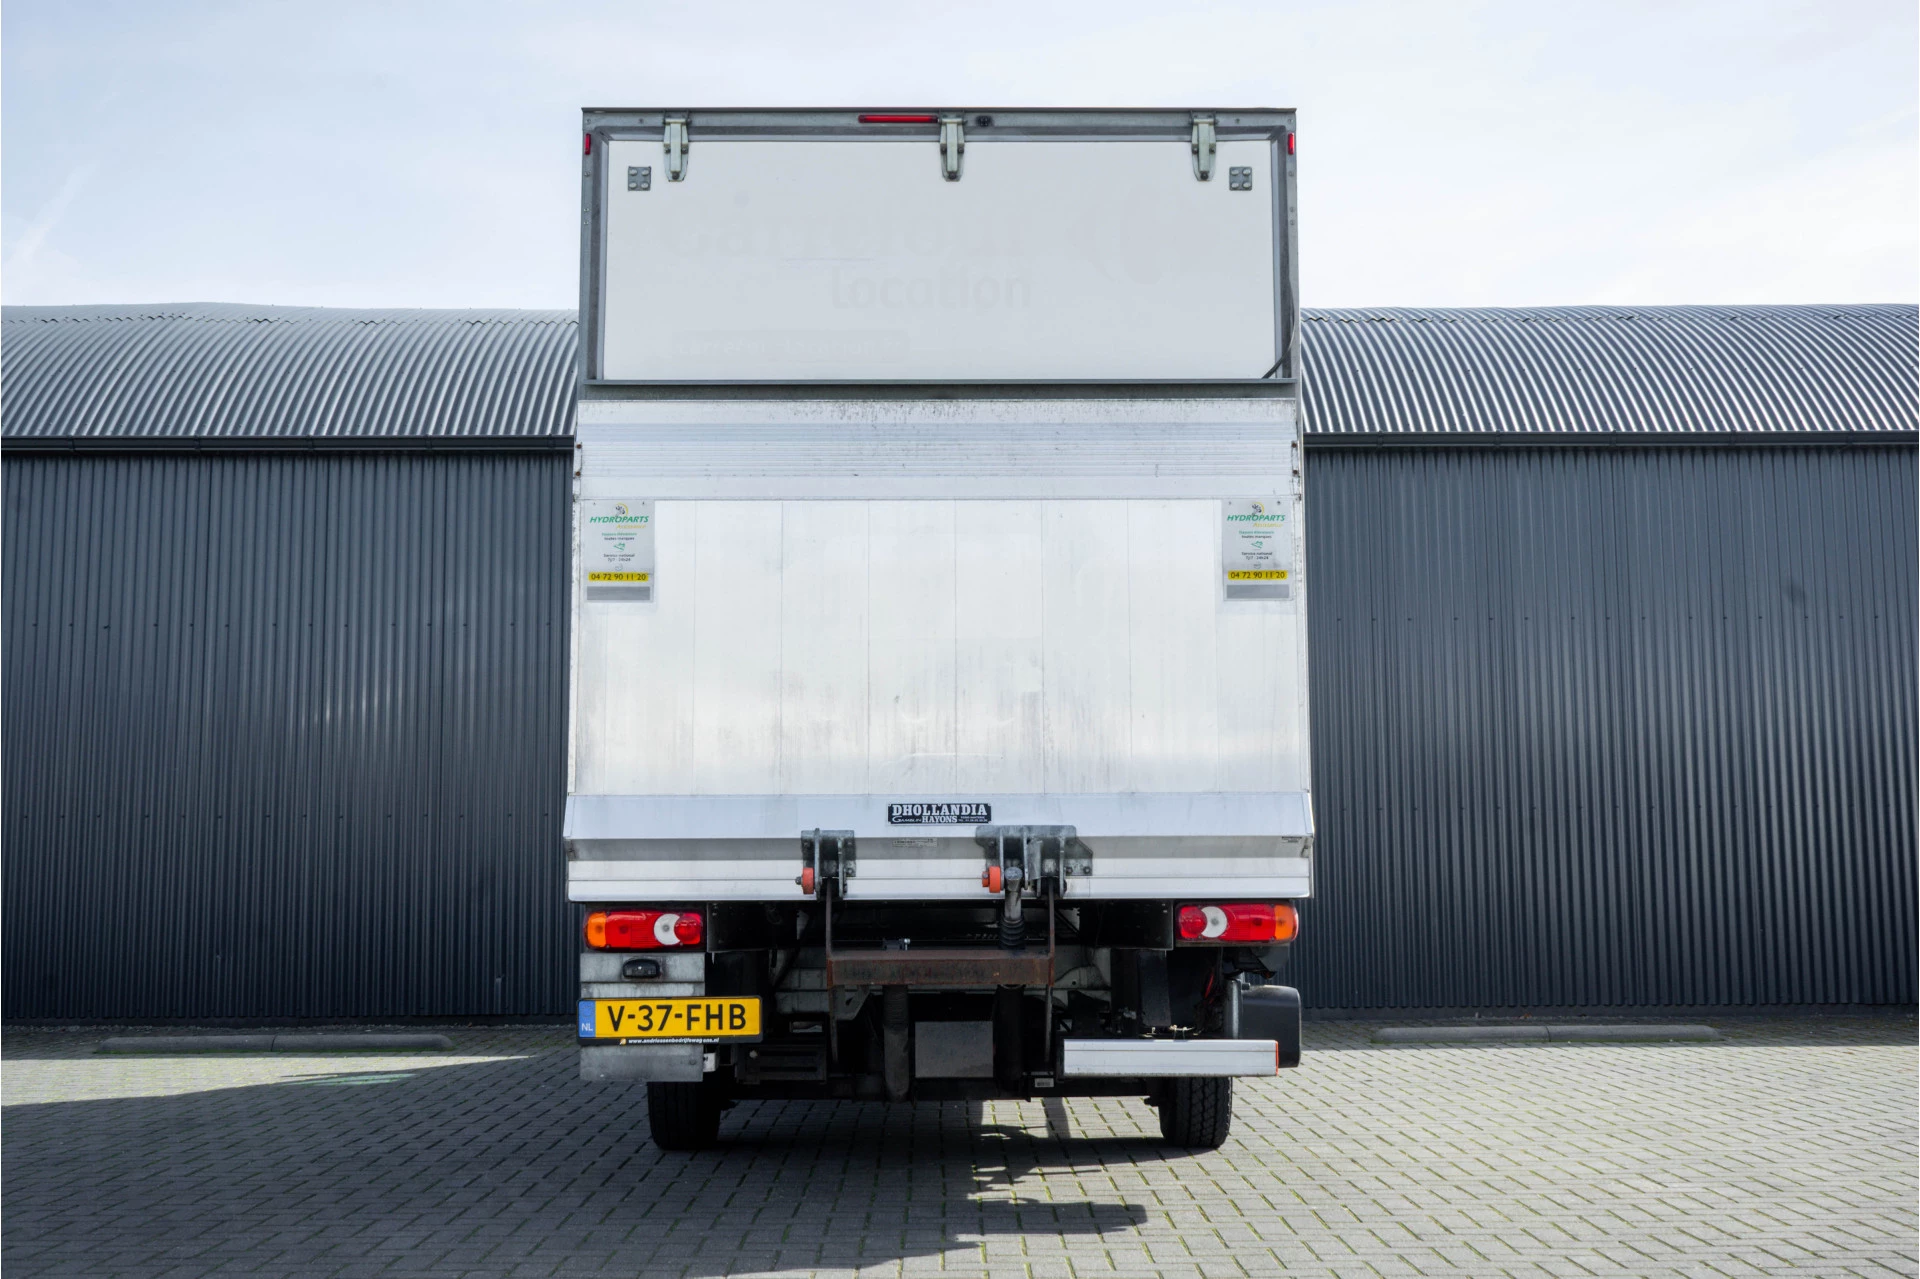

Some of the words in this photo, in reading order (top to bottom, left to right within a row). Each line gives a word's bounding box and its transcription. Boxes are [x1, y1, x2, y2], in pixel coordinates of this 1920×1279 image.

[830, 266, 1031, 309] location
[589, 515, 650, 524] HYDROPARTS
[1227, 514, 1285, 522] HYDROPARTS
[591, 573, 600, 581] 04
[603, 573, 612, 581] 72
[614, 573, 623, 581] 90
[626, 573, 634, 581] 11
[637, 573, 646, 581] 20
[1230, 571, 1240, 579] 04
[1242, 571, 1251, 579] 72
[1253, 571, 1262, 579] 90
[1265, 571, 1273, 579] 11
[1276, 571, 1285, 579] 20
[891, 804, 988, 816] DHOLLANDIA
[922, 815, 958, 823] HAYONS
[607, 1003, 747, 1032] V-37-FHB
[581, 1023, 594, 1032] NL
